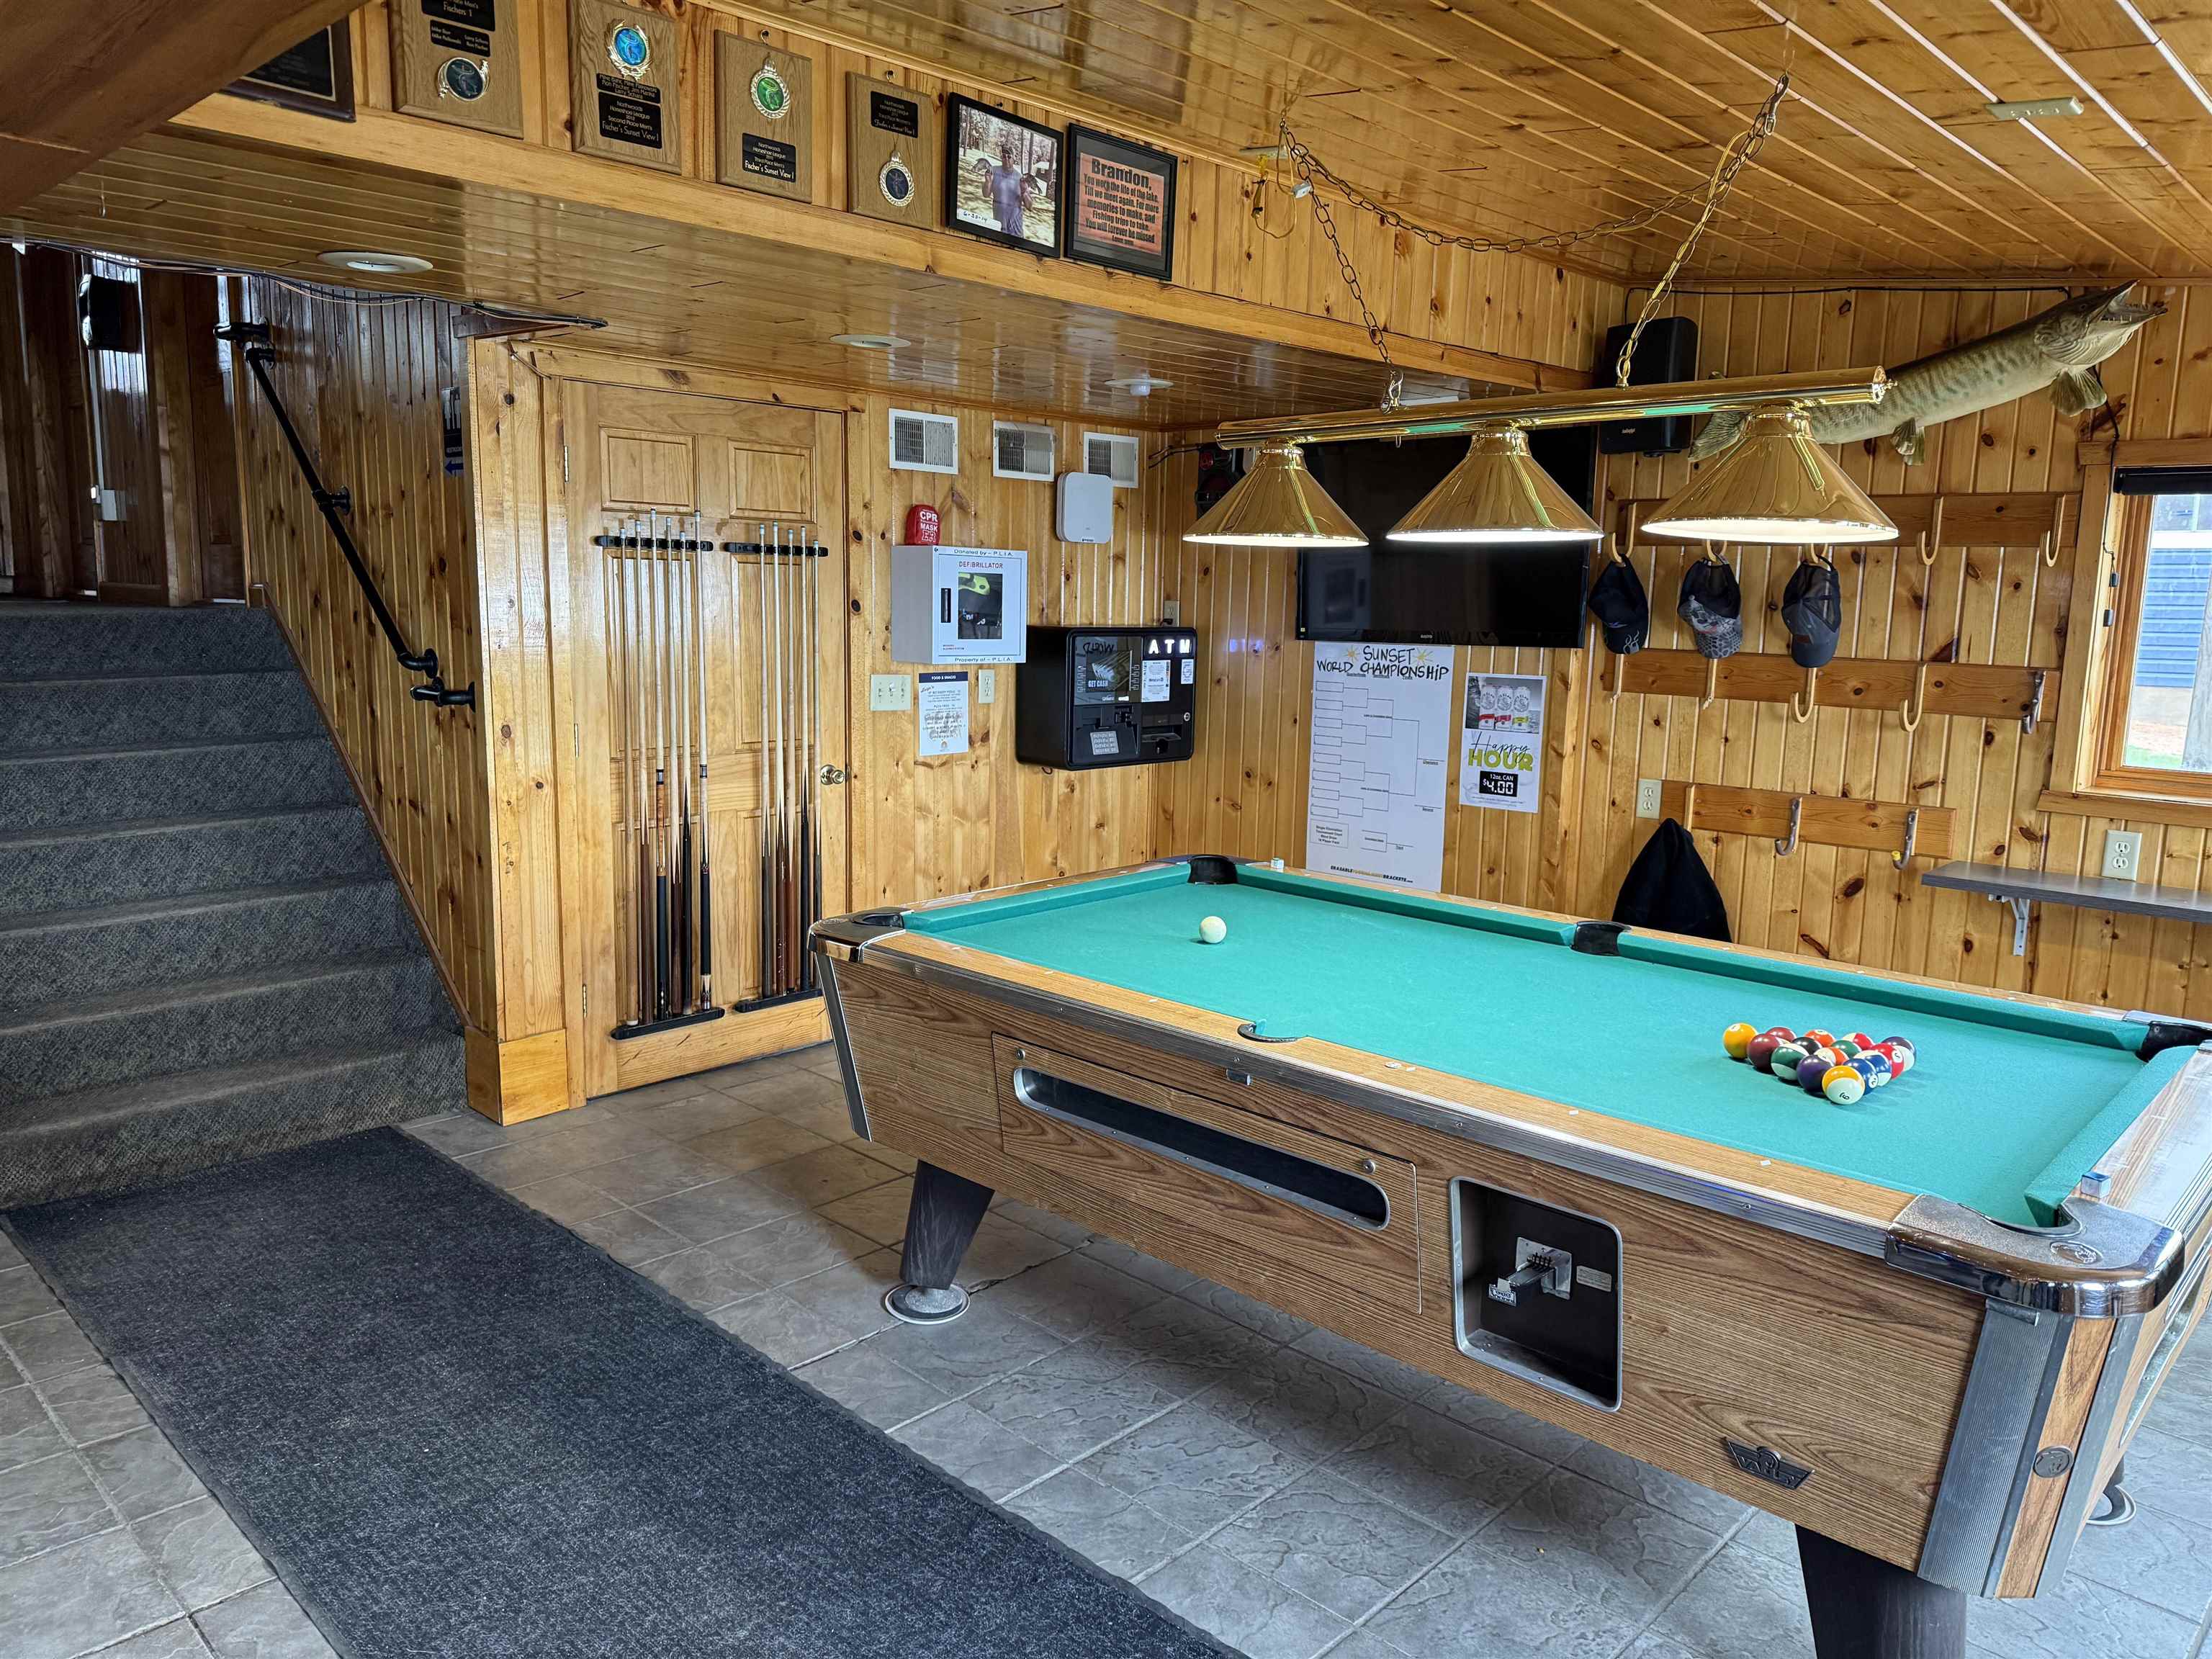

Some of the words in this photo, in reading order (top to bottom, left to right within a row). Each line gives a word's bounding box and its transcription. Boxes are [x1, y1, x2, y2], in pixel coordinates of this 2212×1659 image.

[608, 114, 626, 124] Second
[626, 119, 639, 127] Place
[633, 110, 651, 120] League
[624, 126, 641, 137] Sunset
[641, 130, 656, 140] View
[772, 150, 786, 159] League
[745, 160, 763, 172] Fischer's
[764, 164, 778, 176] Sunset
[779, 168, 791, 179] View
[1092, 158, 1152, 192] Brandon,
[1083, 172, 1095, 186] You
[1094, 177, 1110, 192] were
[1110, 181, 1120, 193] the
[1120, 183, 1130, 195] life
[1130, 187, 1136, 197] of
[1136, 189, 1146, 200] the
[1084, 185, 1094, 197] Till
[1094, 189, 1103, 199] we
[1103, 192, 1118, 203] meet
[1145, 203, 1159, 214] more
[1087, 198, 1119, 215] memories
[1119, 206, 1125, 216] to
[1144, 213, 1156, 224] and
[1092, 210, 1115, 224] Fishing
[1115, 215, 1129, 227] trips
[1129, 220, 1136, 229] to
[1085, 218, 1097, 230] You
[1096, 221, 1107, 232] will
[1107, 223, 1128, 238] forever
[1128, 228, 1136, 239] be
[1136, 230, 1155, 243] missed
[920, 511, 938, 523] CPR
[920, 523, 938, 533] MASK
[958, 560, 1003, 569] DEFIBRILLATOR
[1148, 639, 1191, 655] ATM
[1362, 645, 1415, 665] SUNSET
[1316, 659, 1354, 673] WORLD
[1096, 679, 1109, 688] CASH
[1470, 731, 1531, 764] Happy
[1468, 747, 1534, 773] HOUR
[1483, 778, 1514, 794] $4.00
